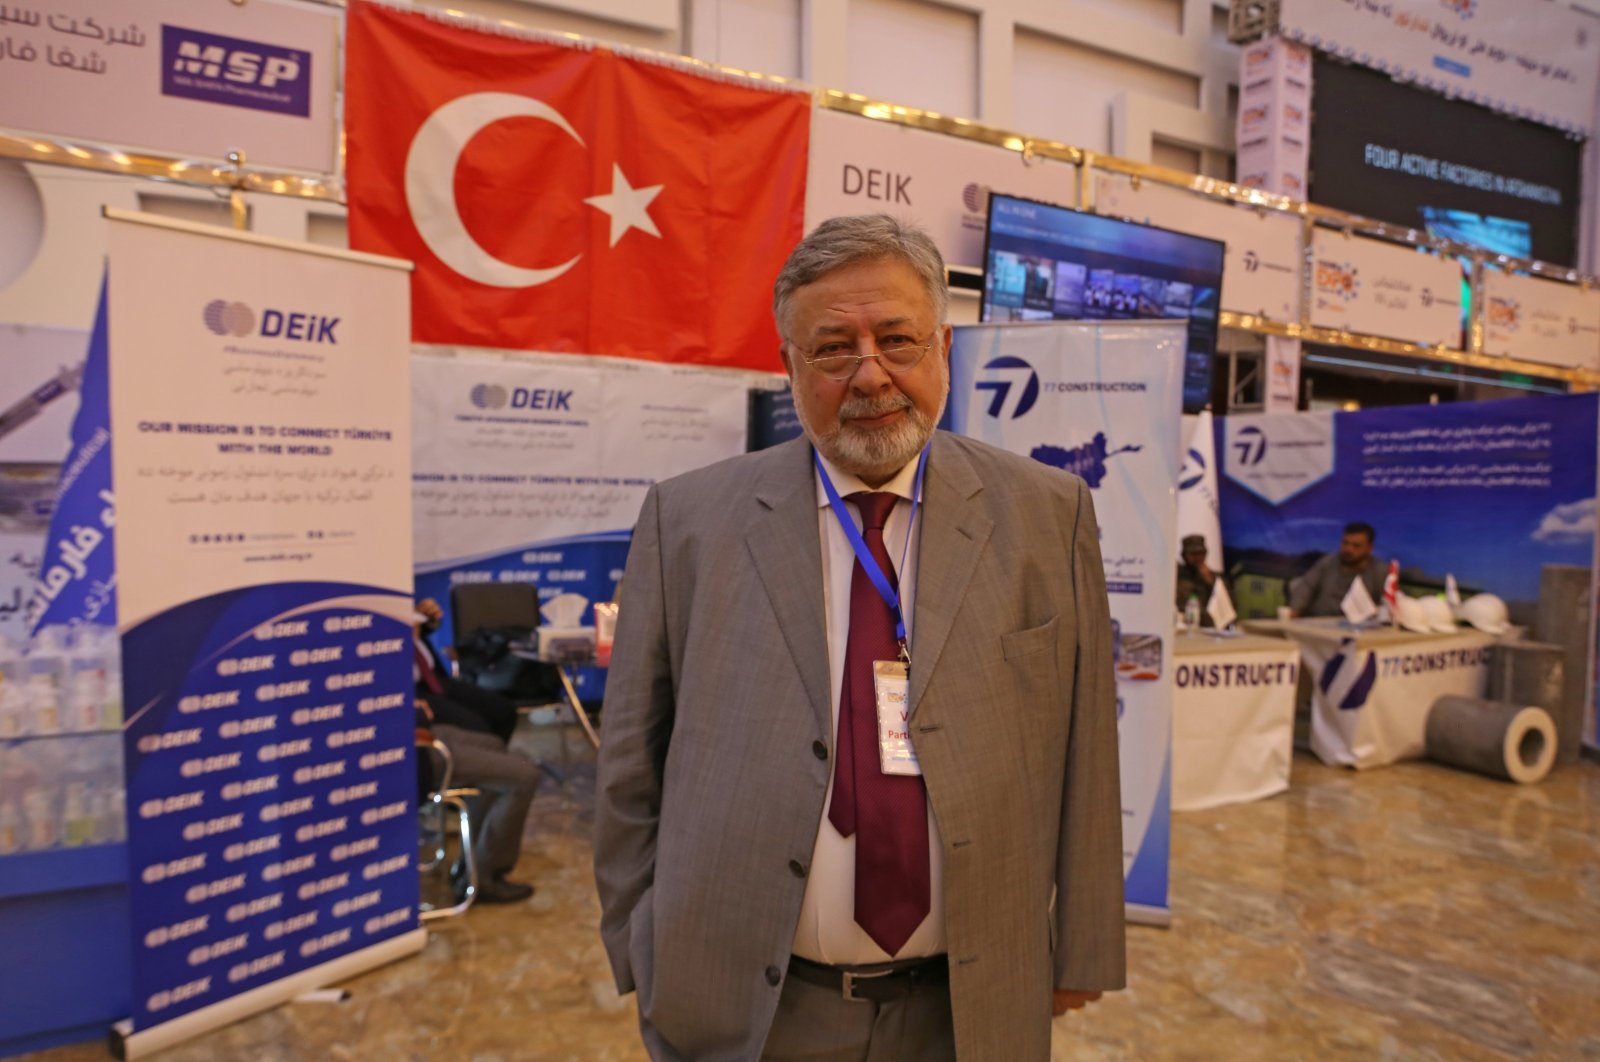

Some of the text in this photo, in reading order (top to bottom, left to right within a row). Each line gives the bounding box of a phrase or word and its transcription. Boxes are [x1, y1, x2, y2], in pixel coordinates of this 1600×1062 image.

[47, 14, 146, 47] شرکت
[46, 44, 107, 74] شفا
[173, 40, 300, 88] MSP
[1365, 143, 1399, 169] FOUR
[1400, 152, 1440, 180] ACTIVE
[1441, 161, 1493, 191] FACTORIES
[843, 164, 912, 206] DEIK
[1058, 382, 1146, 392] CONSTRUCTION
[138, 421, 172, 433] OUR
[177, 422, 239, 435] MISSION
[243, 424, 254, 436] IS
[259, 426, 276, 437] TO
[279, 427, 340, 439] CONNECT
[218, 442, 333, 456] WITH THE WORLD
[1382, 656, 1399, 678] 77
[888, 729, 910, 740] Parti
